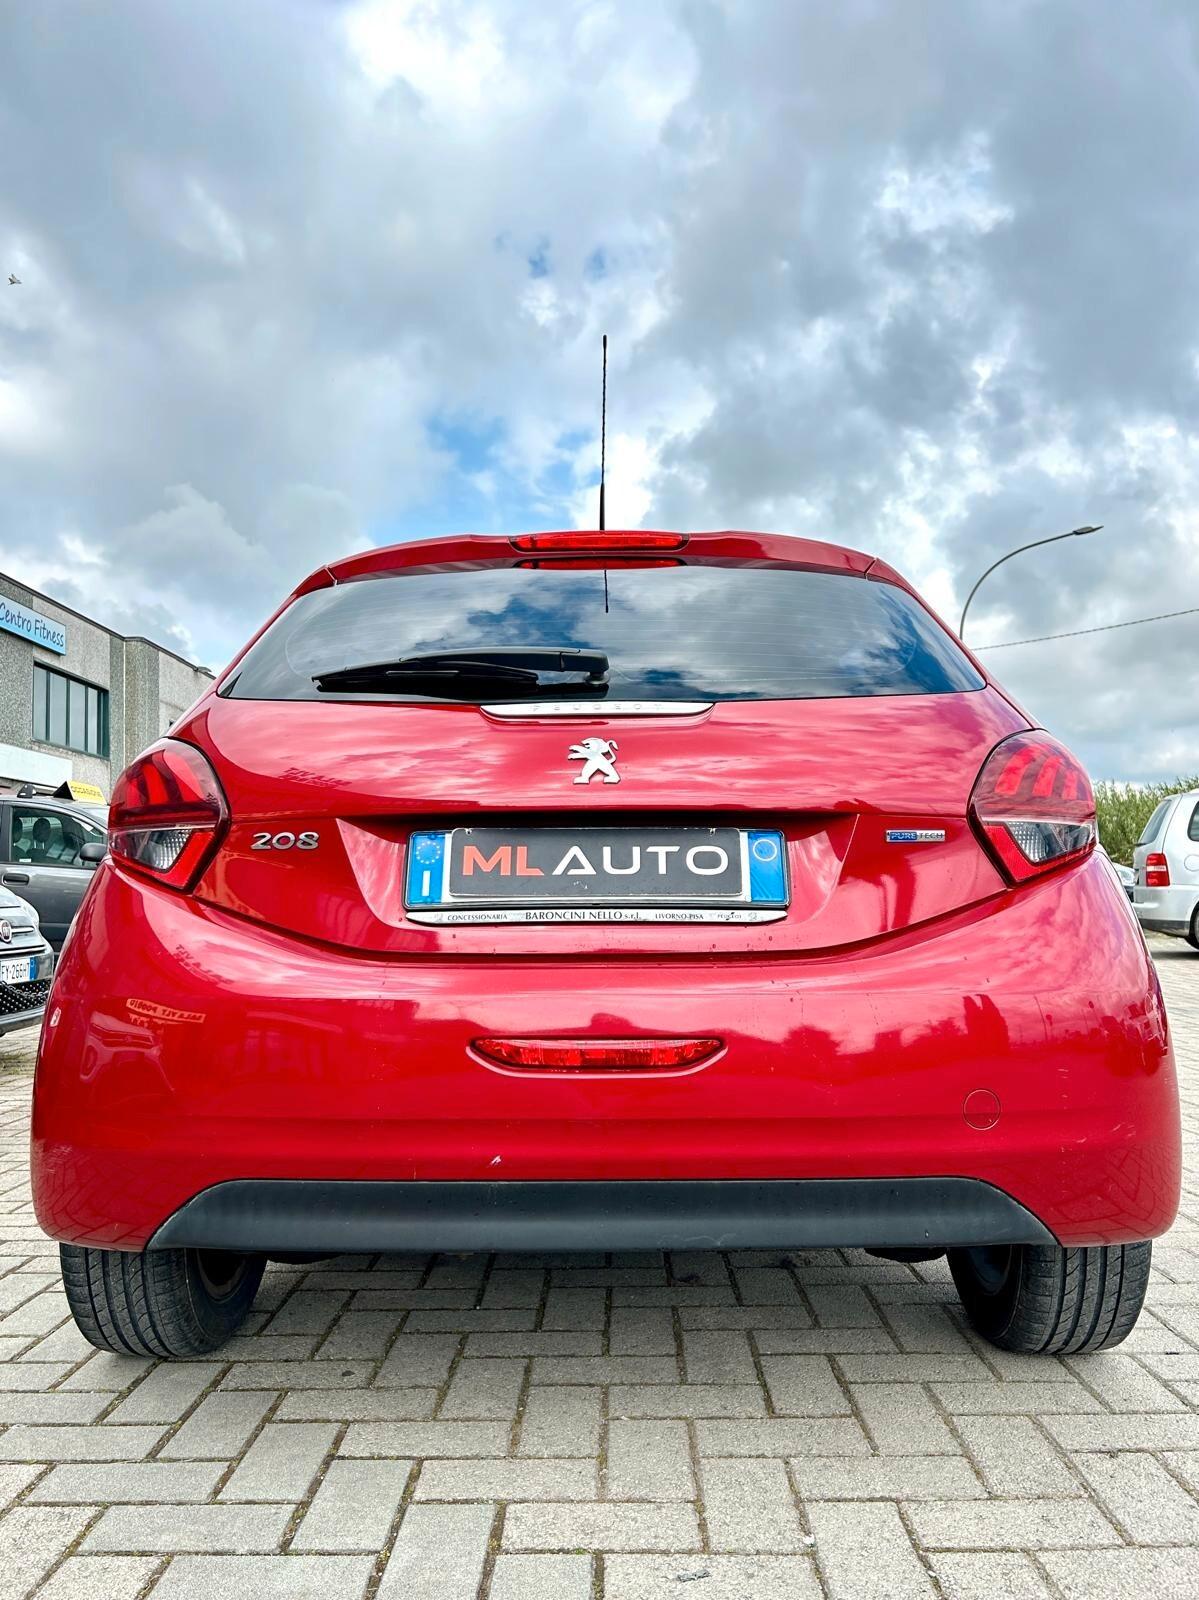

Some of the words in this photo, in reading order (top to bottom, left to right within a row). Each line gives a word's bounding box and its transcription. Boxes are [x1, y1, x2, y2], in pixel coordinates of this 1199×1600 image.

[0, 602, 31, 632] Centro
[34, 618, 65, 647] Fitness
[531, 703, 664, 712] PEUGEOT
[250, 831, 320, 850] 208
[462, 845, 545, 877] ML
[552, 845, 730, 876] AUTO
[447, 914, 508, 922] CONCESSIONARIA
[525, 911, 586, 920] BARONCINI
[589, 911, 623, 920] NELLO
